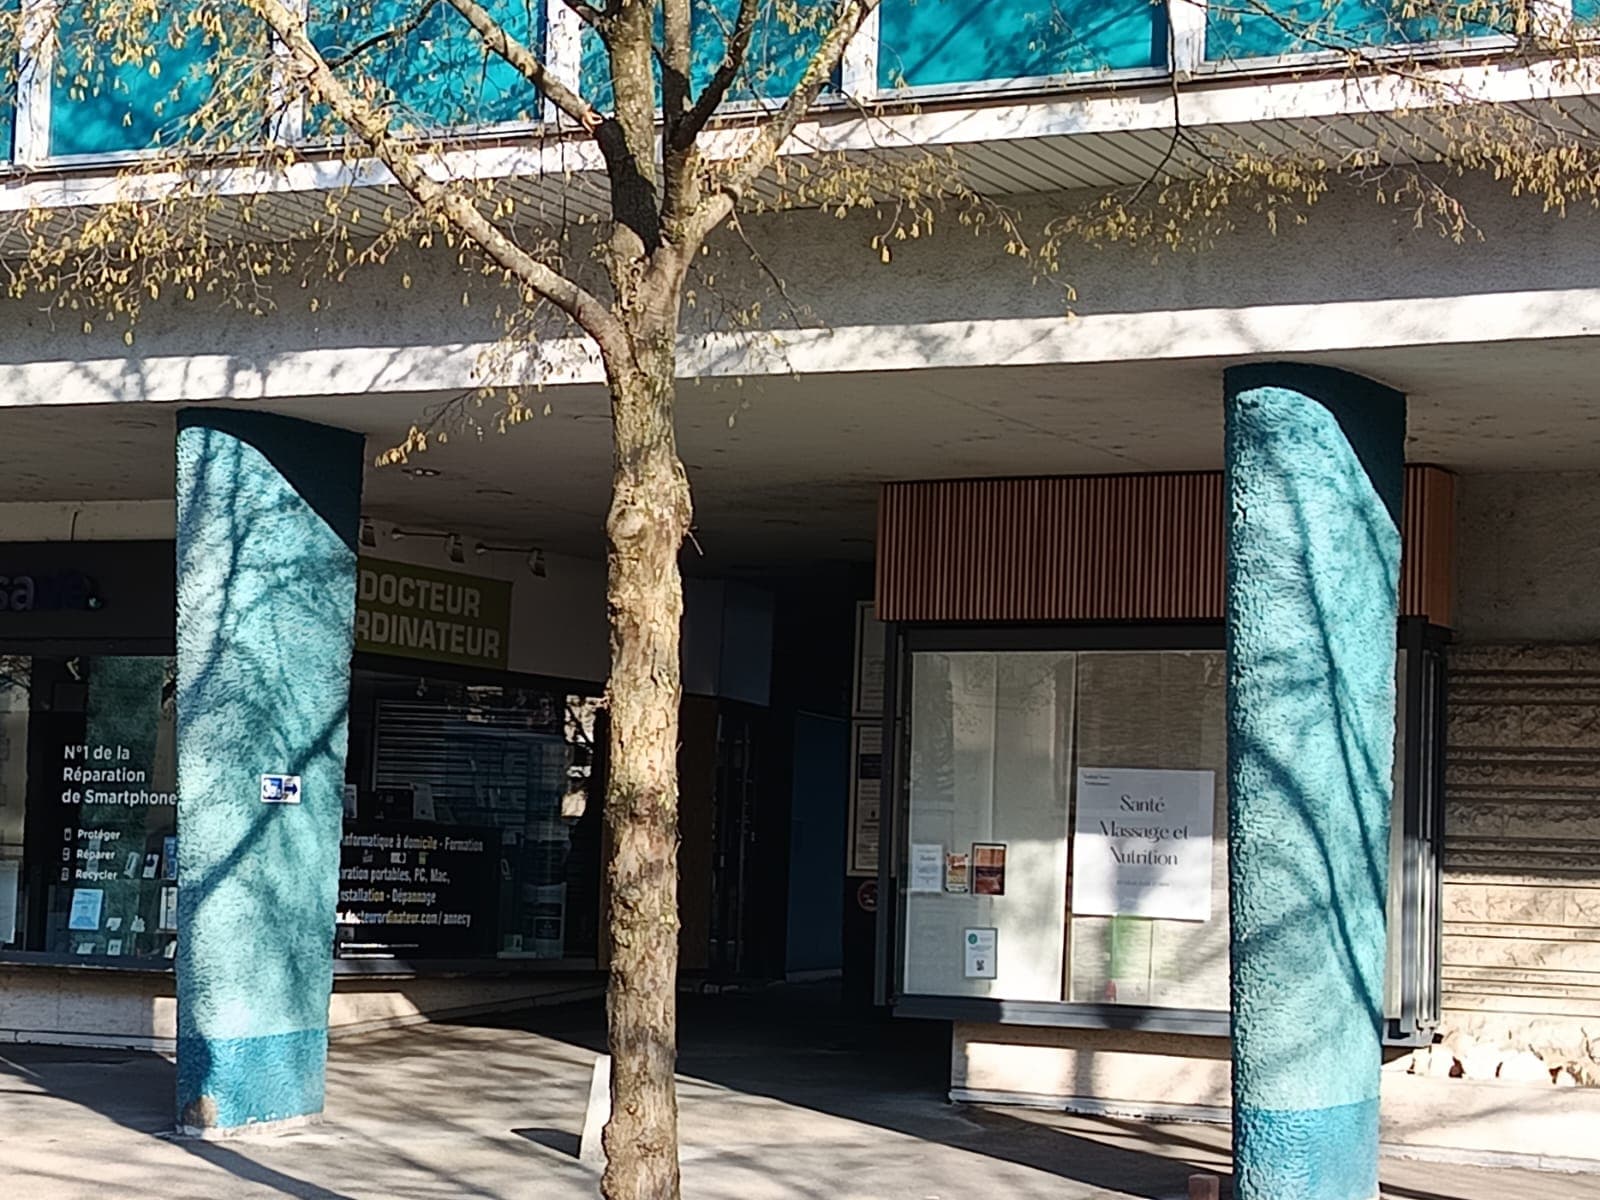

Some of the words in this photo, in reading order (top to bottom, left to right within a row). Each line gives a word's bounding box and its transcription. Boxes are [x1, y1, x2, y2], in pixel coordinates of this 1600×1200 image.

[359, 569, 481, 618] DOCTEUR
[93, 745, 112, 760] de
[117, 745, 130, 760] la
[63, 766, 146, 784] Réparation
[61, 788, 81, 804] de
[84, 789, 177, 808] Smartphone
[1119, 794, 1166, 812] Santé
[77, 828, 121, 842] Protéger
[1099, 820, 1169, 843] Massage
[1173, 825, 1189, 840] et
[403, 834, 438, 851] domicile
[444, 836, 484, 853] Formation
[76, 848, 116, 861] Réparer
[1109, 846, 1178, 865] Nutrition
[75, 868, 117, 882] Recycler
[391, 888, 437, 911] Dépannage
